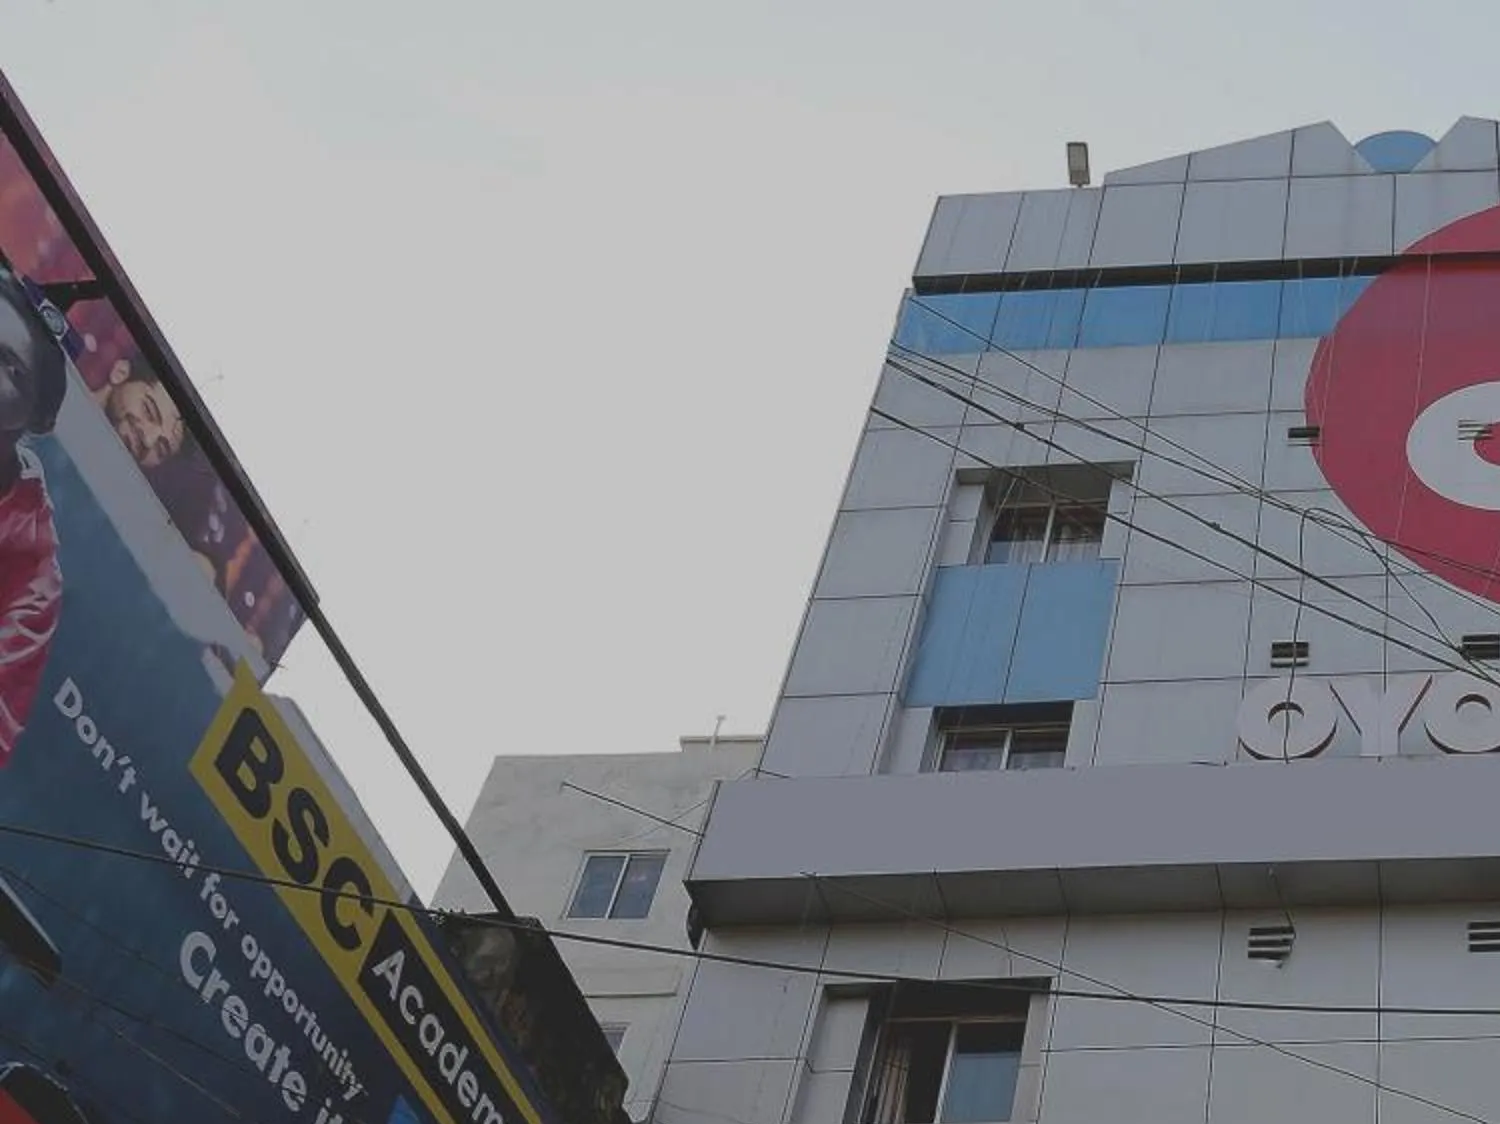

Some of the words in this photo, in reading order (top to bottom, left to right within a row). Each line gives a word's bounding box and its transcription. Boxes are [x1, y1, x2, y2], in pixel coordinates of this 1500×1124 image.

[53, 676, 137, 794] Don't
[140, 791, 203, 878] wait
[200, 871, 239, 930] for
[241, 933, 366, 1100] opportunity
[213, 707, 374, 952] BSC
[180, 931, 307, 1112] Create
